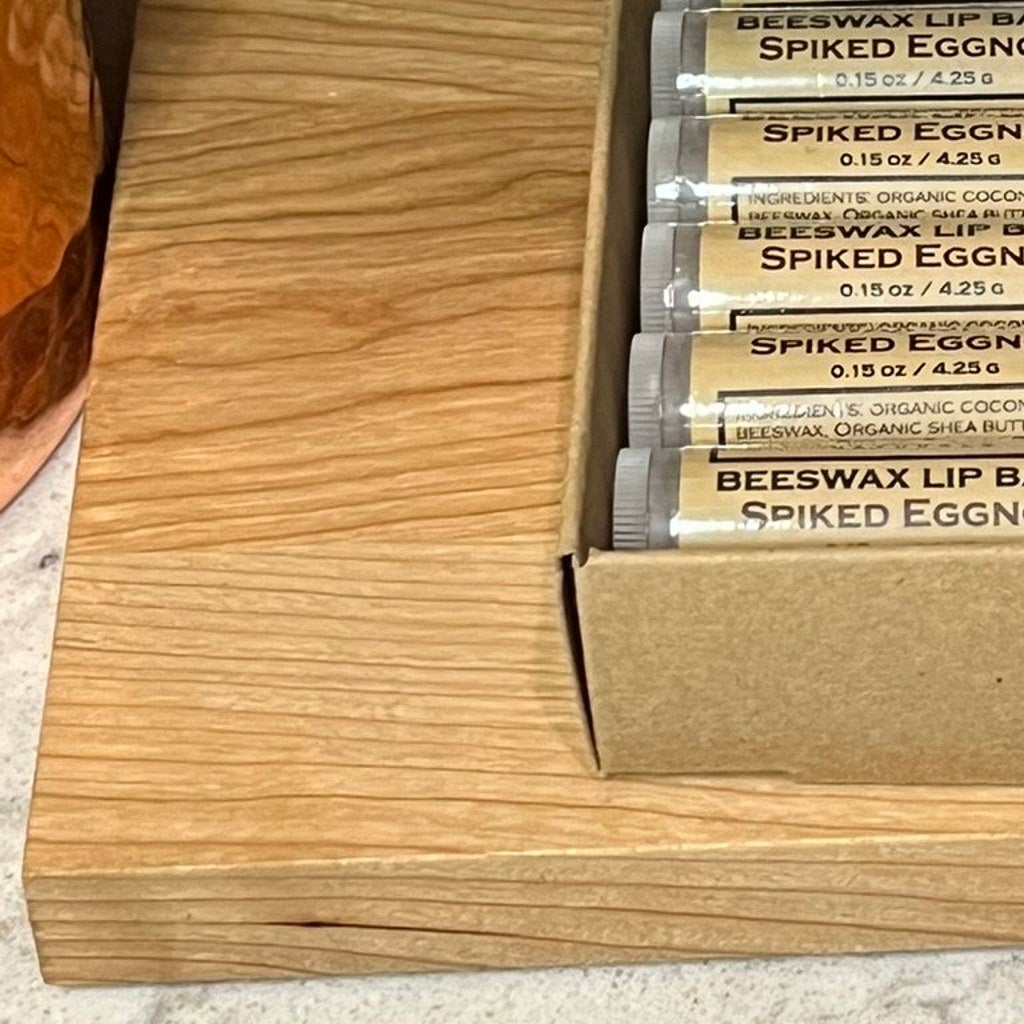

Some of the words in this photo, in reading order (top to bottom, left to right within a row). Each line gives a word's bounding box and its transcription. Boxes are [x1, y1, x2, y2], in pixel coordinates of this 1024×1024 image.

[737, 12, 914, 31] BEESWAX
[925, 12, 981, 28] LIP
[759, 36, 896, 61] SPIKED
[835, 72, 877, 87] 0.15
[912, 70, 925, 87] /
[763, 124, 902, 143] SPIKED
[839, 152, 883, 168] 0.15
[918, 151, 931, 167] /
[935, 151, 984, 166] 4.25
[877, 190, 957, 205] ORGANIC
[738, 225, 921, 241] BEESWAX
[934, 224, 991, 238] LIP
[761, 246, 903, 271] SPIKED
[840, 282, 884, 298] 0.15
[919, 281, 933, 297] /
[938, 281, 989, 297] 4.25
[750, 337, 896, 356] SPIKED
[830, 363, 876, 379] 0.15
[912, 361, 927, 377] /
[931, 361, 983, 376] 4.25
[869, 401, 955, 418] ORGANIC
[834, 421, 922, 437] ORGANIC
[928, 419, 978, 435] SHEA
[716, 467, 910, 492] BEESWAX
[923, 467, 983, 489] LIP
[741, 500, 890, 530] SPIKED
